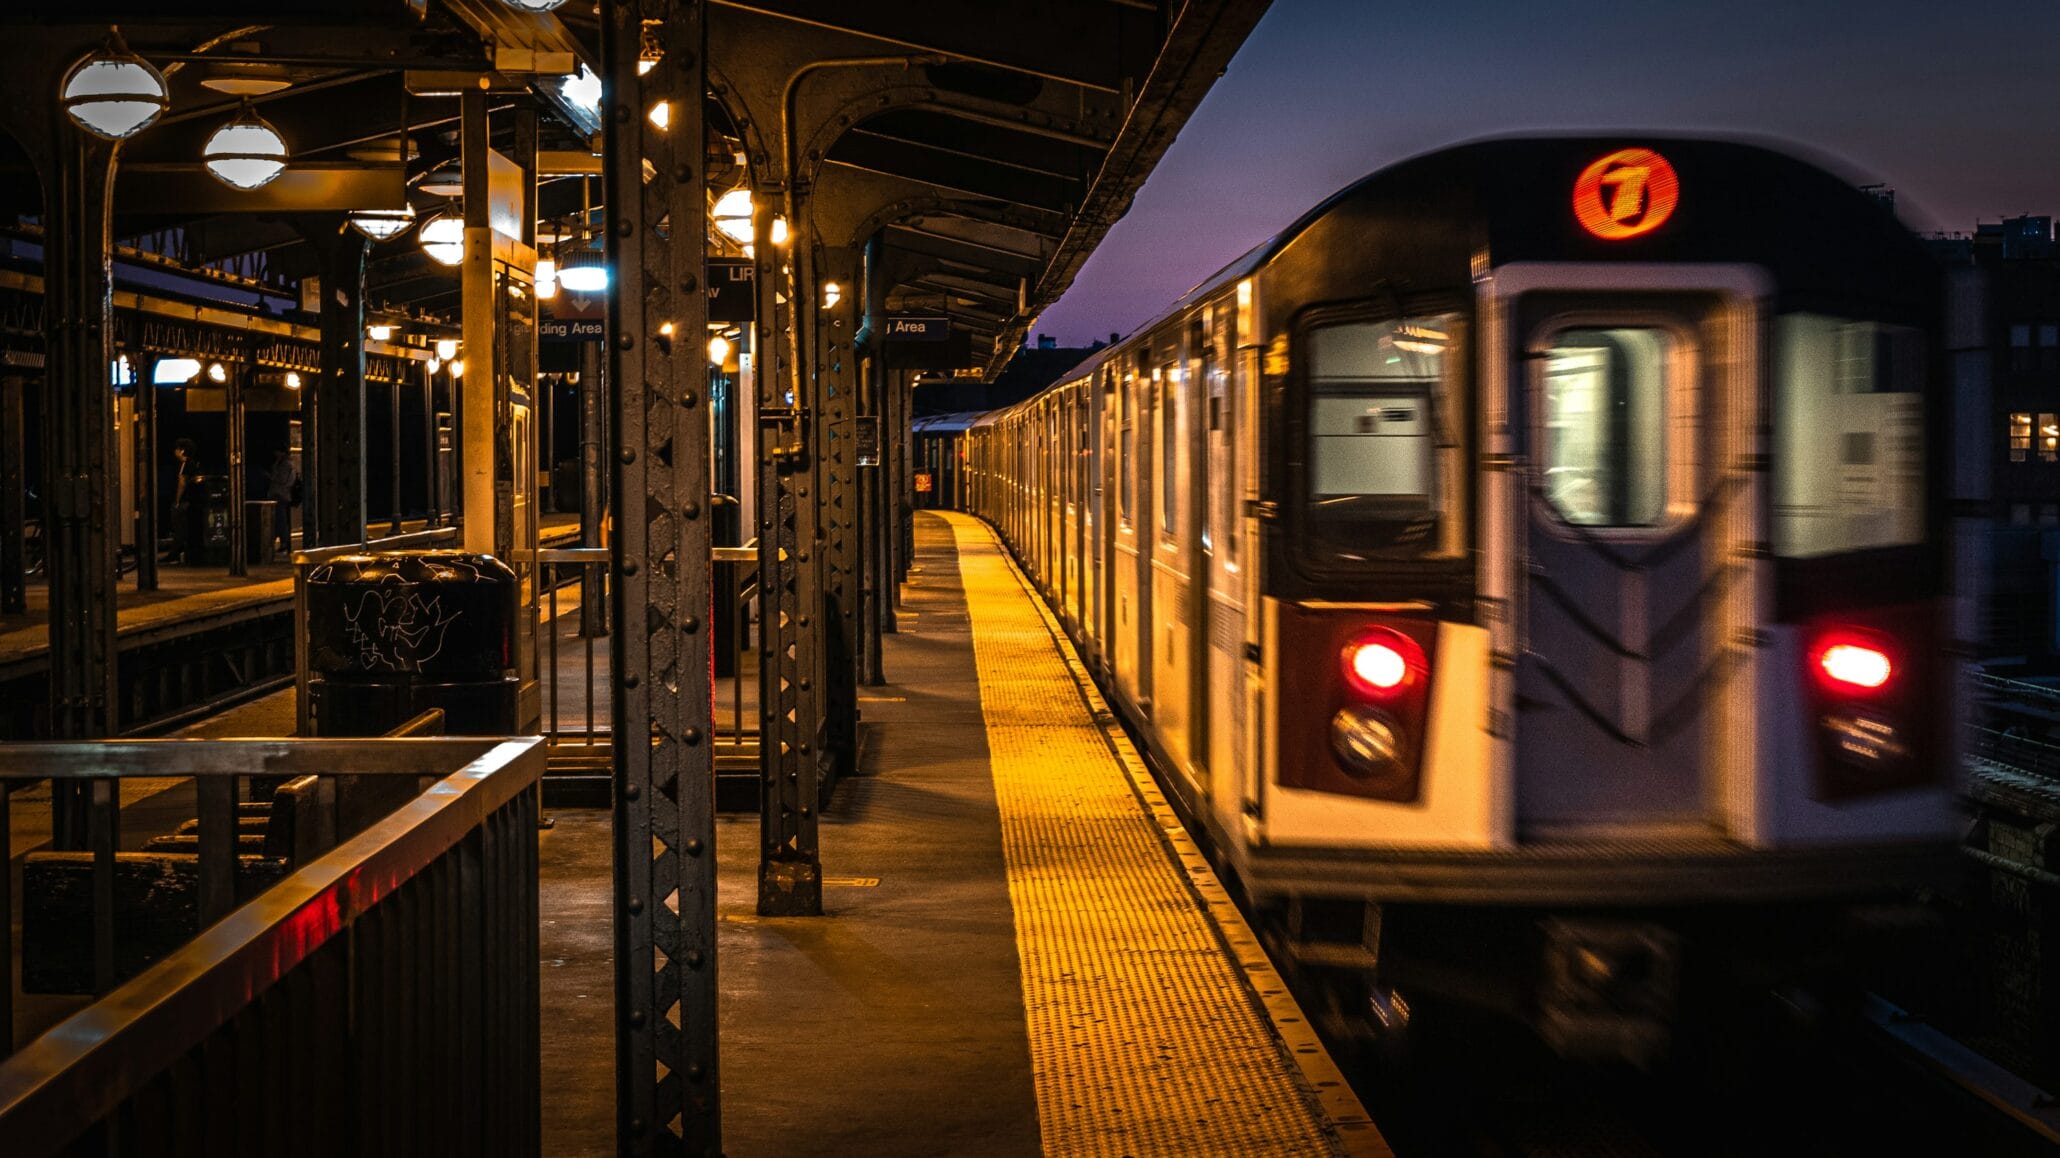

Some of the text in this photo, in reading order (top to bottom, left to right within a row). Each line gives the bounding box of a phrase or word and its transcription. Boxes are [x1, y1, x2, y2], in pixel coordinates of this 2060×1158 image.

[601, 166, 651, 221] 7
[540, 322, 567, 337] ding
[571, 322, 603, 334] Area
[895, 321, 926, 333] Area
